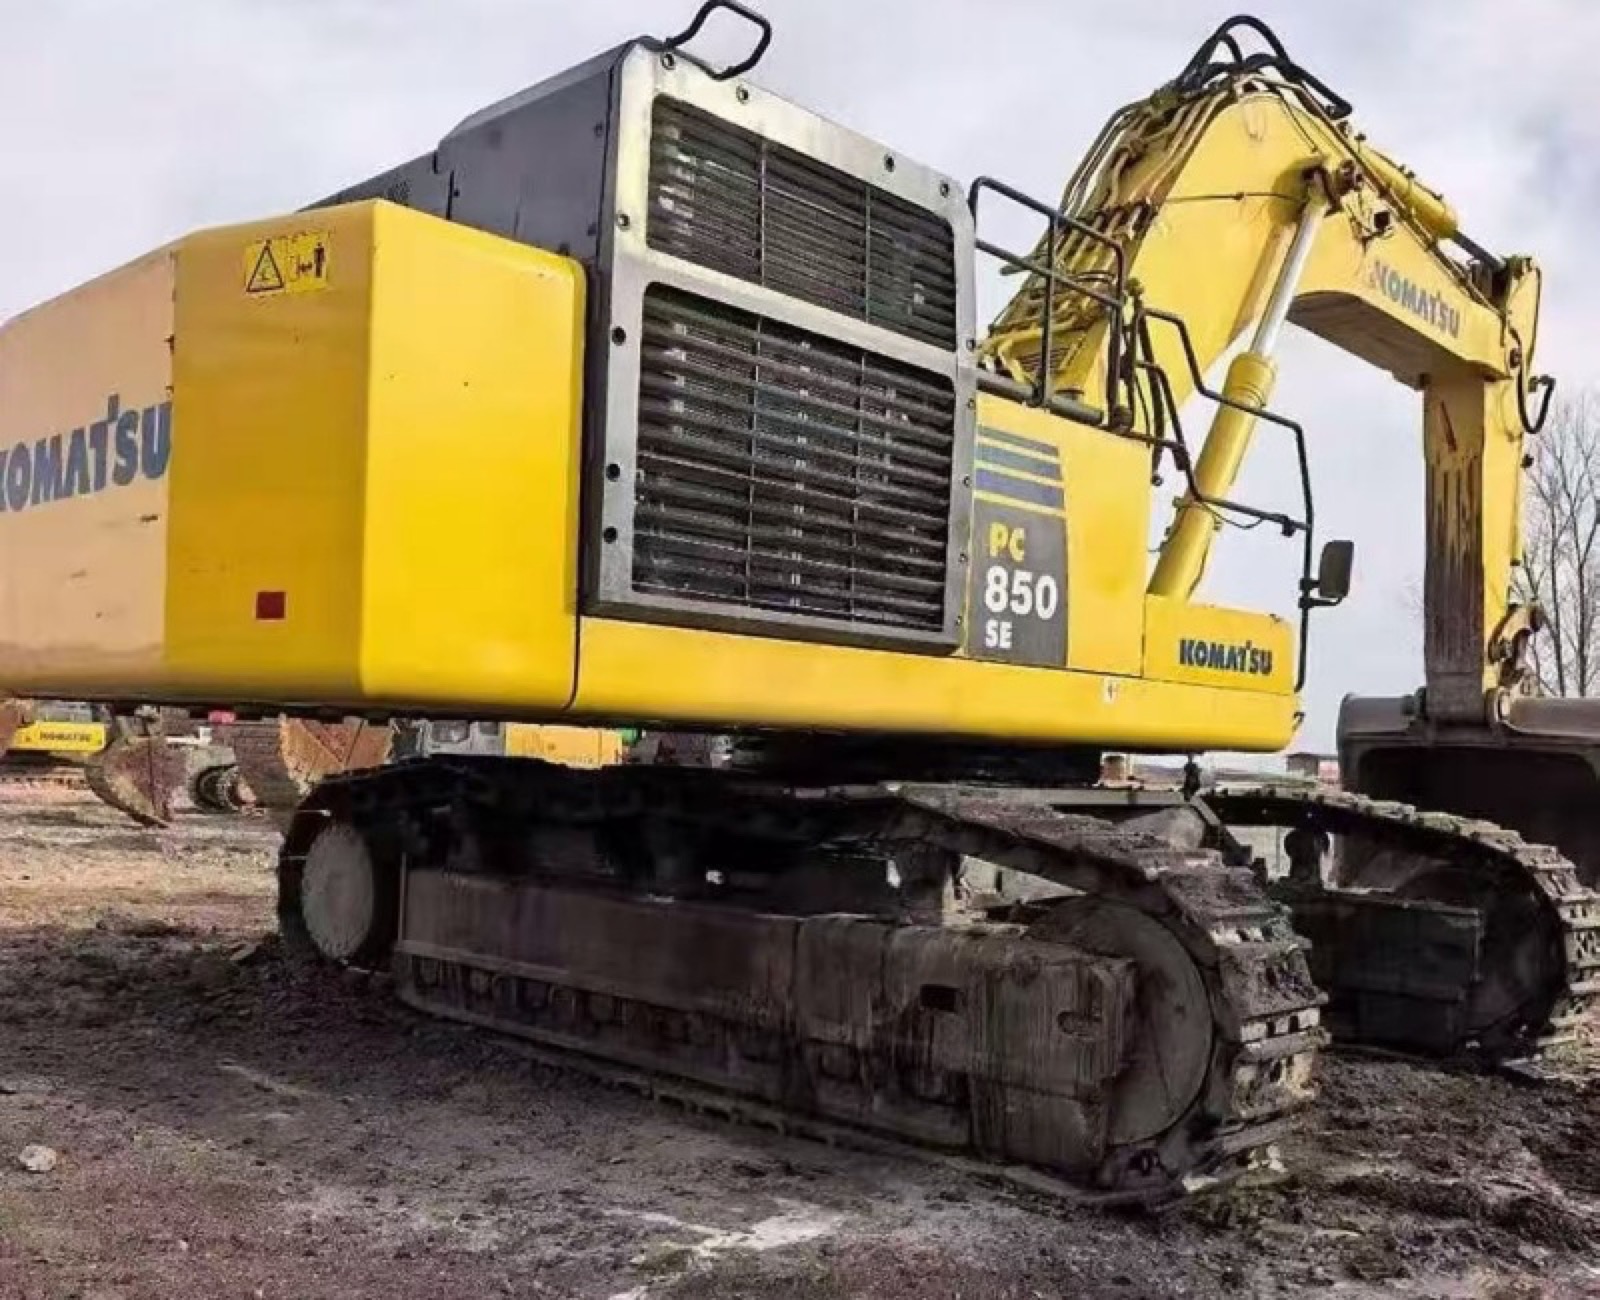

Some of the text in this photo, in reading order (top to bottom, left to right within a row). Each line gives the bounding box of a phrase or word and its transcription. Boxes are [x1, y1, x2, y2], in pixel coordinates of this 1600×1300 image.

[1374, 260, 1459, 338] KOMATSU
[989, 522, 1025, 562] PC
[985, 565, 1057, 620] 850
[985, 618, 1012, 648] SE
[1179, 638, 1272, 675] KOMATSU
